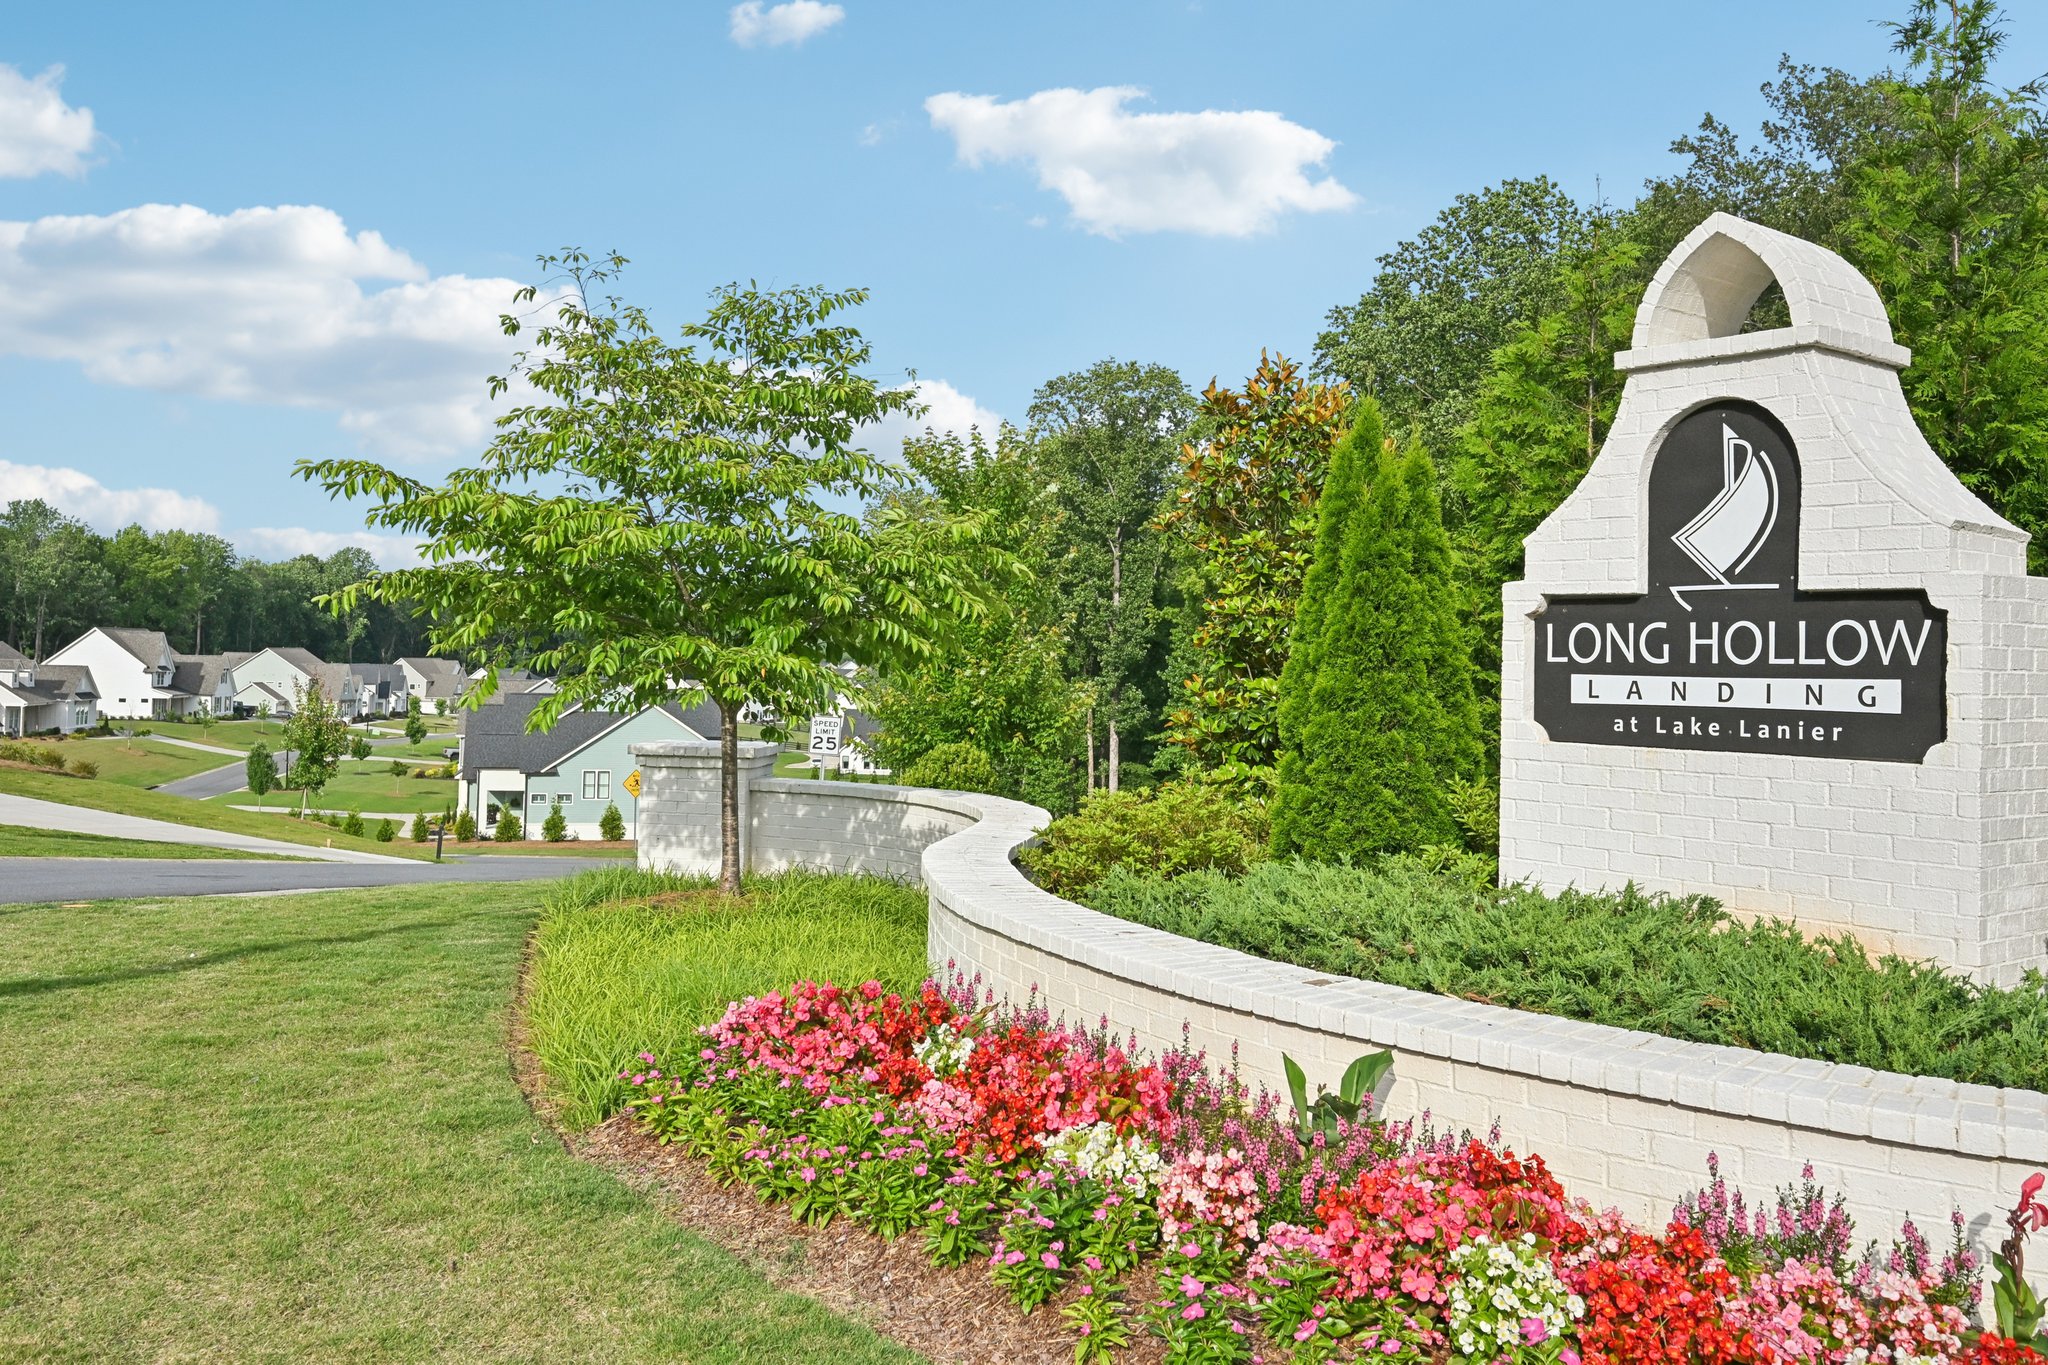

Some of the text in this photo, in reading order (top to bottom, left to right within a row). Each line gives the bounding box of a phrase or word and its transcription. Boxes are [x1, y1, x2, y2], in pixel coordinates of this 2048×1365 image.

[1546, 620, 1932, 666] LONG HOLLOW
[1588, 679, 1876, 708] LANDING
[813, 720, 839, 728] SPEED
[1613, 717, 1844, 741] at Lake Lanier
[812, 736, 837, 750] 25
